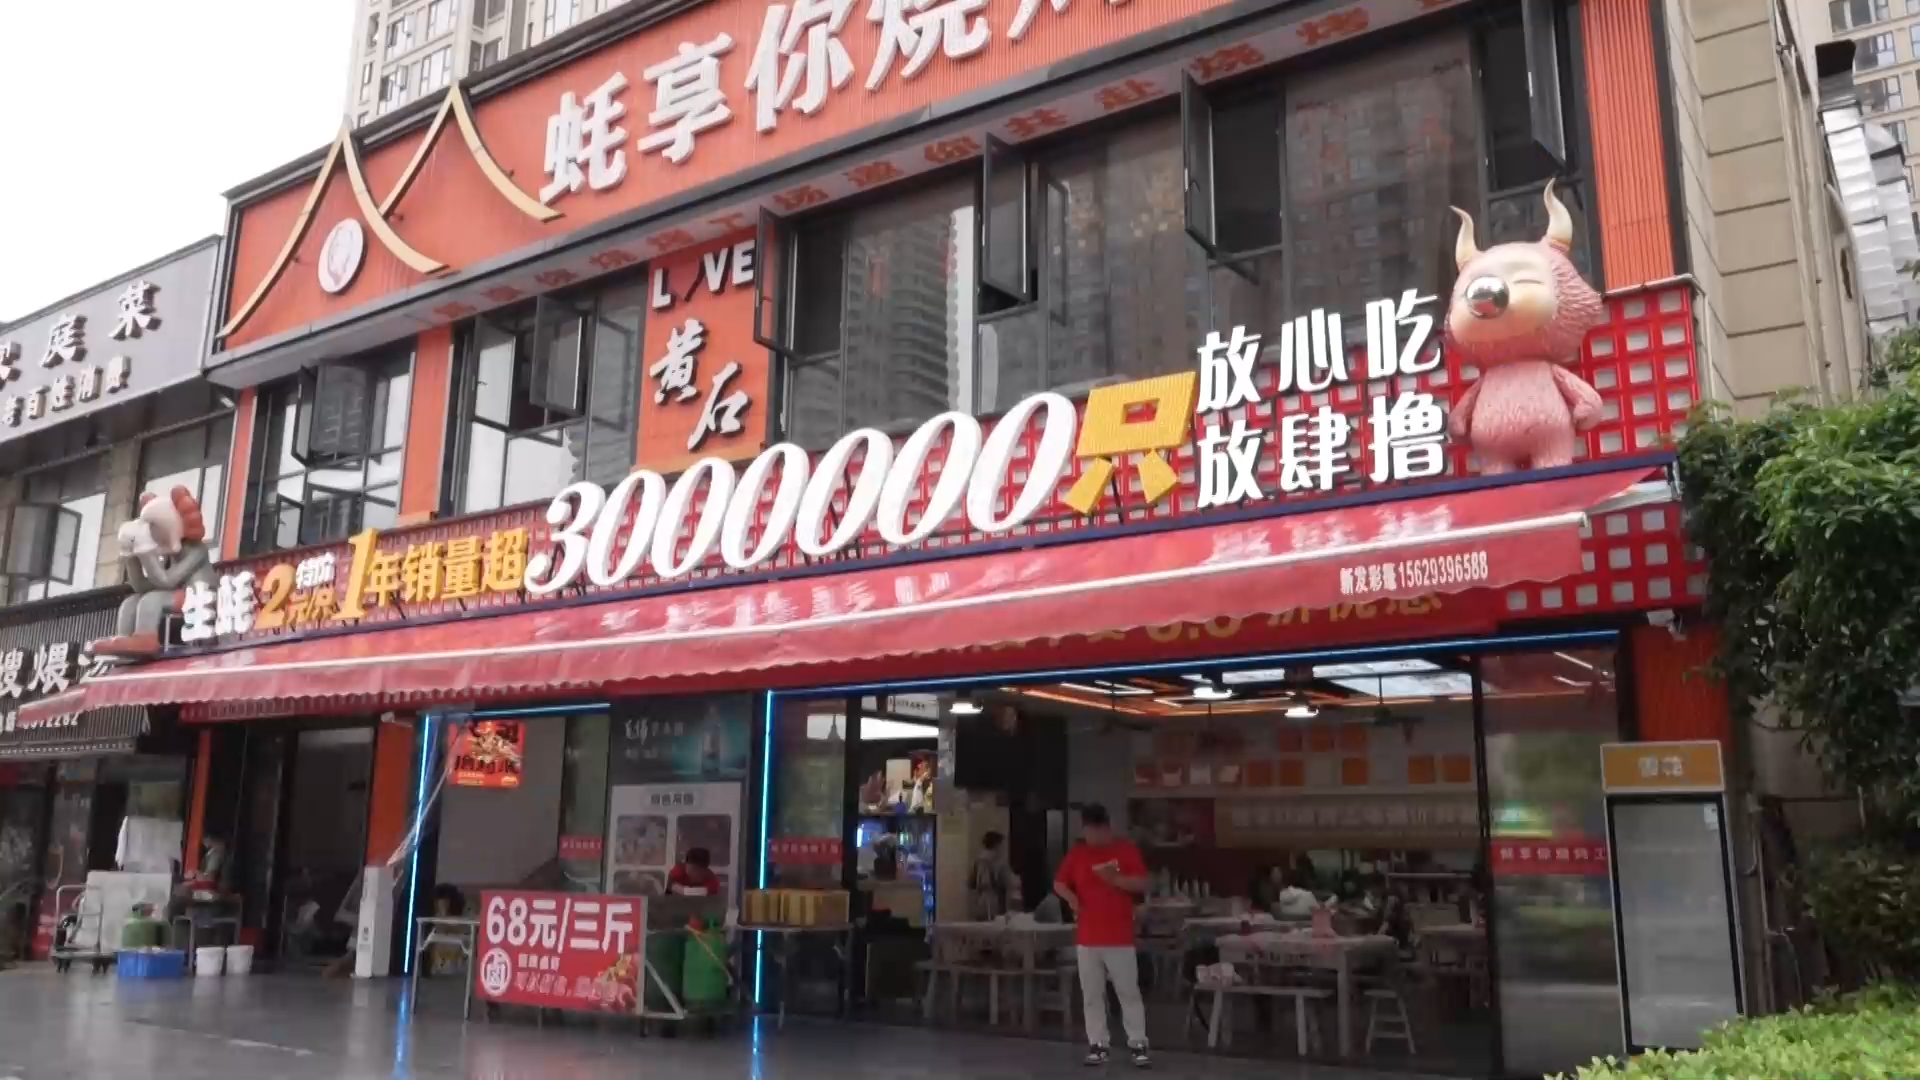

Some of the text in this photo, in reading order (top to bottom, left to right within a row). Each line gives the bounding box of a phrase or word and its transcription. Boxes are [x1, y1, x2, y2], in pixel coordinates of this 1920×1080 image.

[539, 0, 1126, 205] 蚝享你烧
[1198, 288, 1442, 414] 放心吃
[1198, 389, 1448, 507] 放肆撸
[181, 570, 256, 642] 生蚝
[487, 896, 633, 954] 68元/三斤
